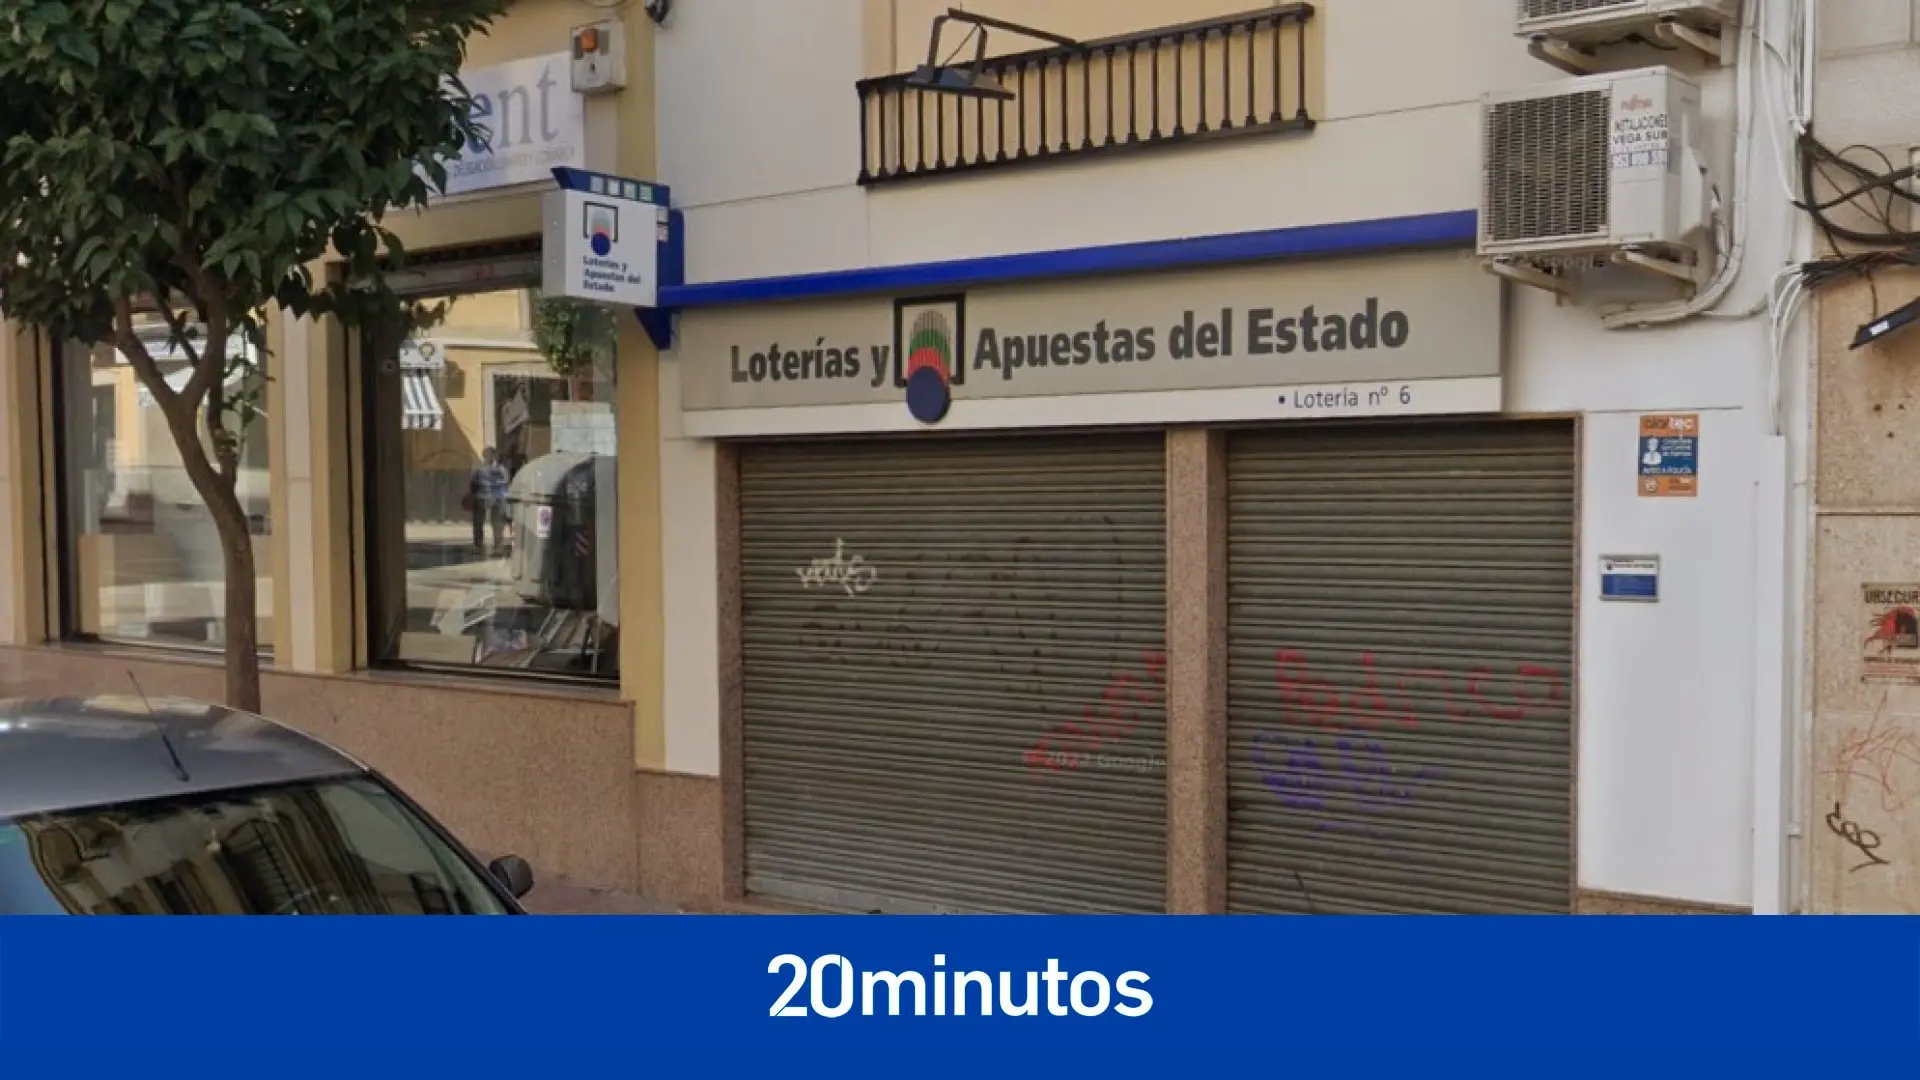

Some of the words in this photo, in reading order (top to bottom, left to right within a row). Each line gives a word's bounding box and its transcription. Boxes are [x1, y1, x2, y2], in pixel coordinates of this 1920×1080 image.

[730, 337, 860, 383] Loterías
[870, 345, 889, 388] y
[973, 319, 1155, 380] Apuestas
[1169, 308, 1232, 361] del
[1248, 297, 1409, 355] Estado
[1400, 386, 1411, 404] 6
